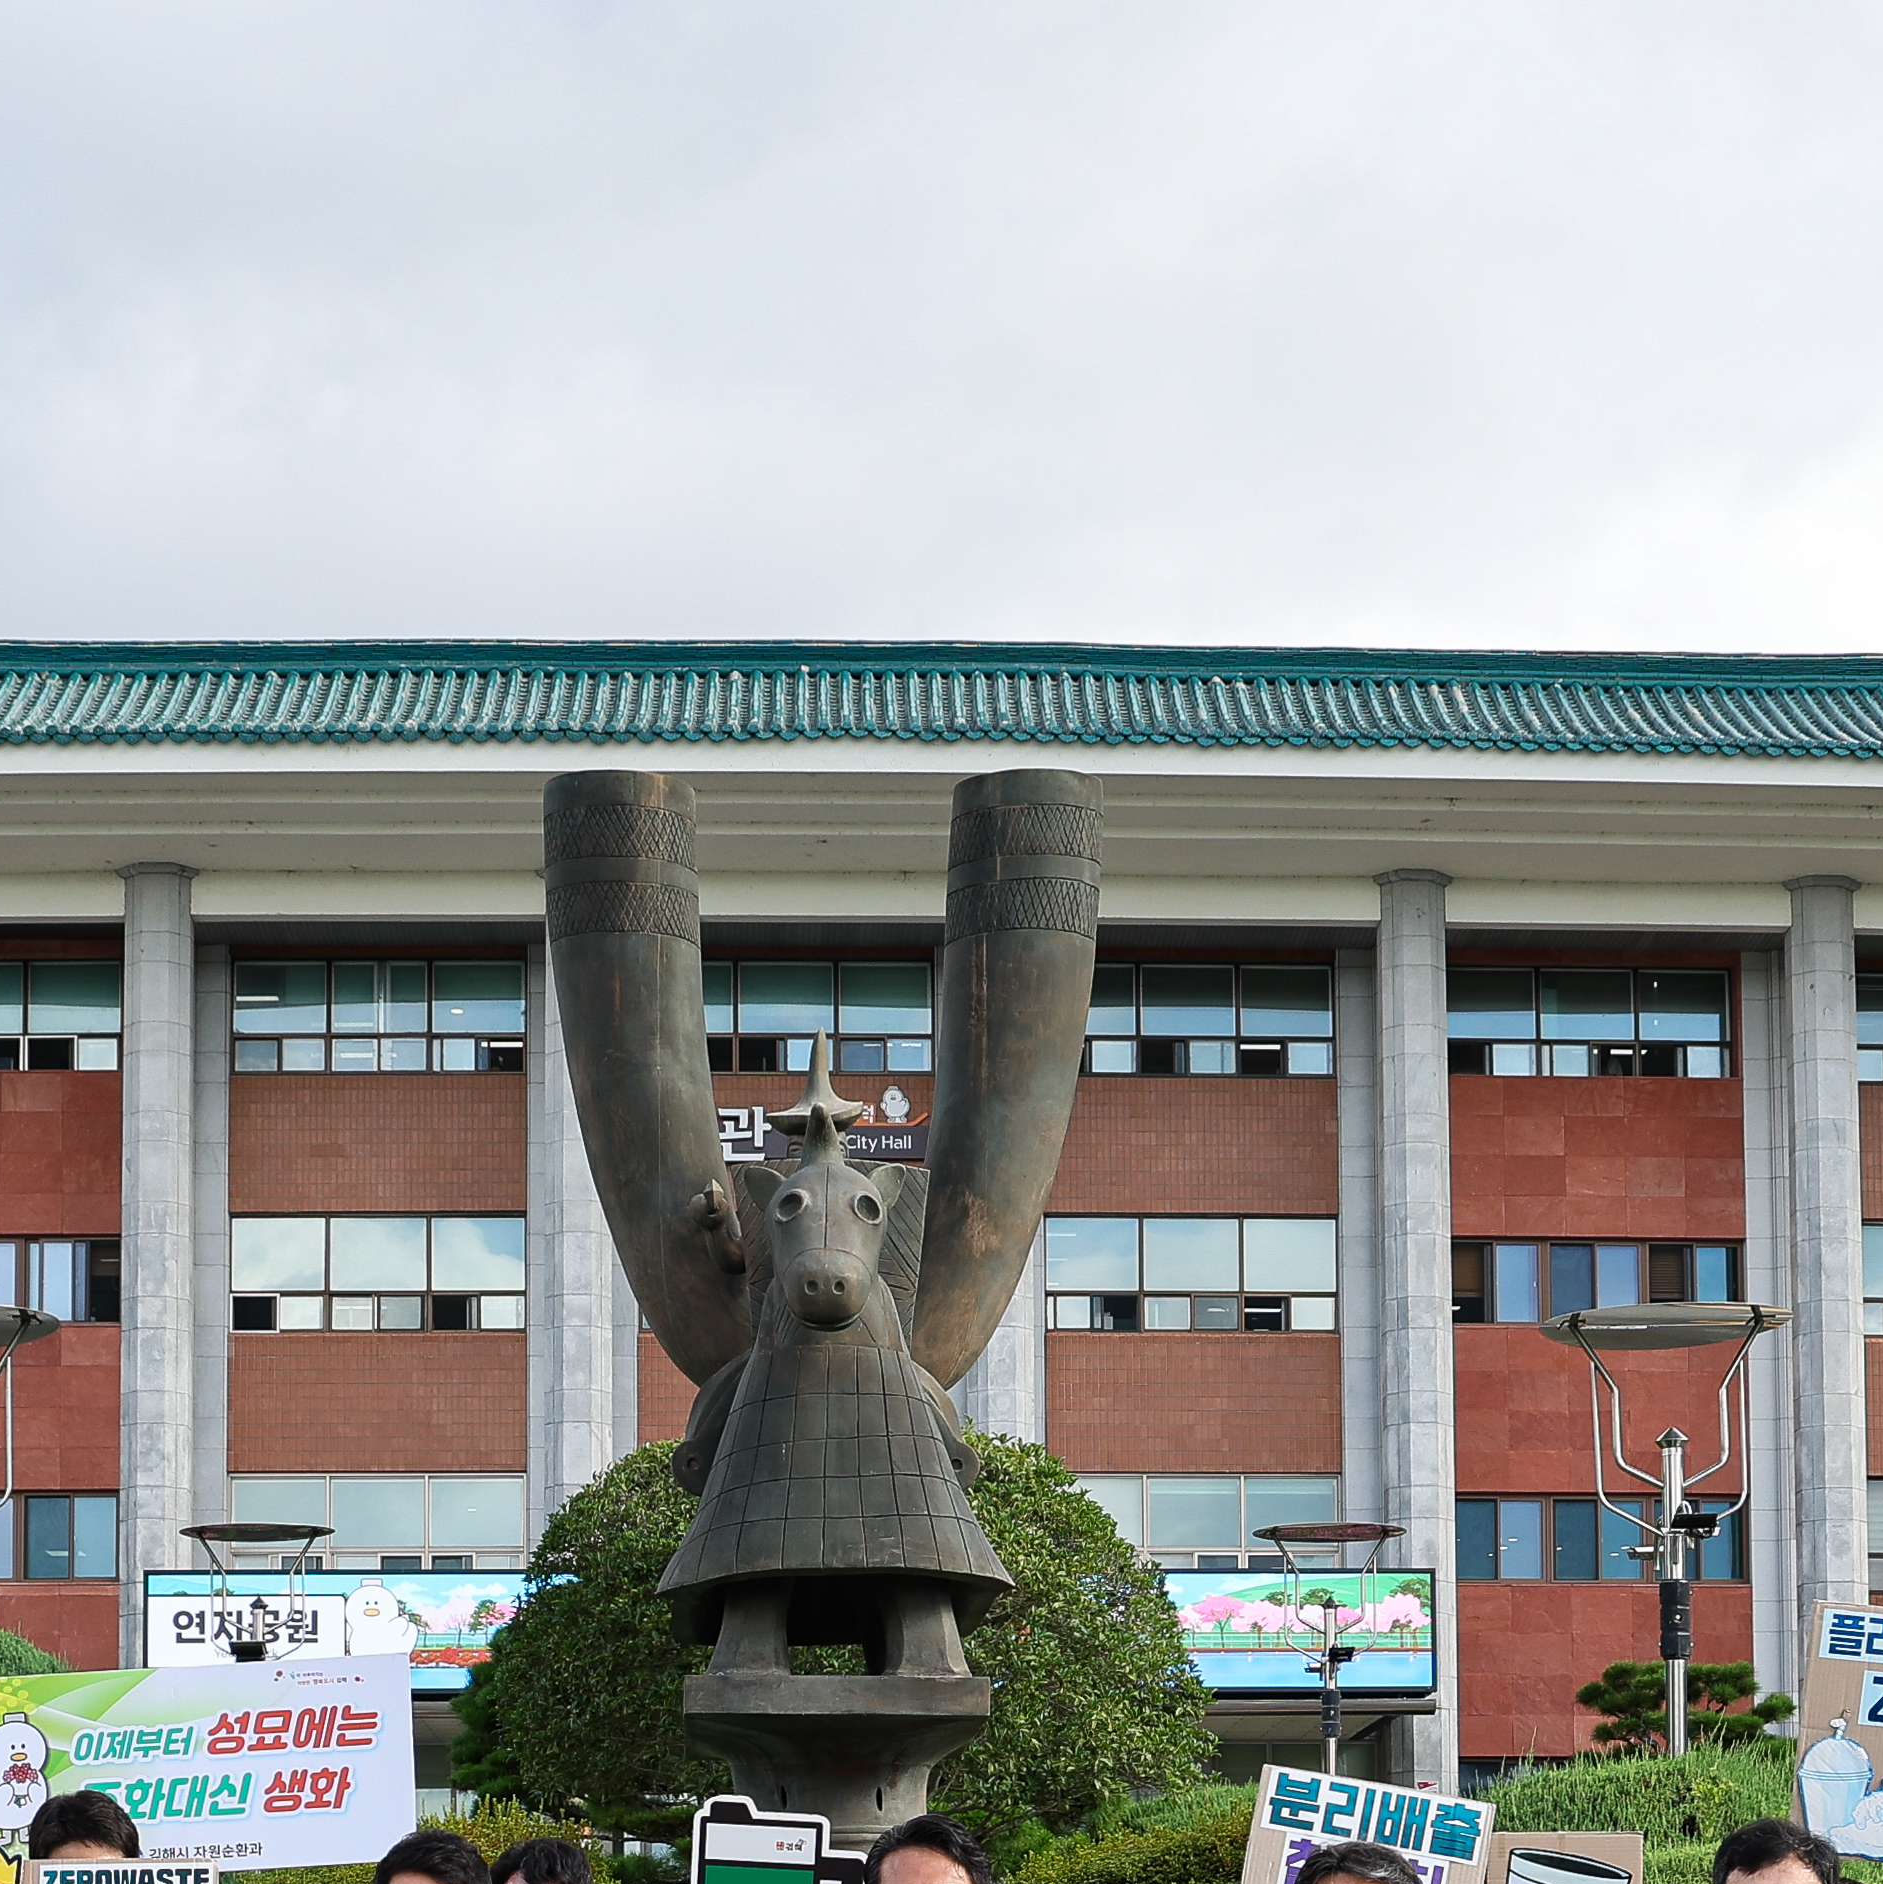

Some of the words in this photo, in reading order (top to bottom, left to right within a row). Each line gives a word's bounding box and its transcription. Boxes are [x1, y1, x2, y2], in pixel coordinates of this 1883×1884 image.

[846, 1134, 878, 1152] City
[881, 1134, 912, 1150] Hall
[74, 1725, 195, 1761] 이제부터
[206, 1704, 379, 1756] 성묘에는
[263, 1765, 352, 1813] 생화
[1268, 1772, 1482, 1862] 분리배출
[149, 1847, 190, 1861] 김해시
[193, 1842, 263, 1860] 자원순환과
